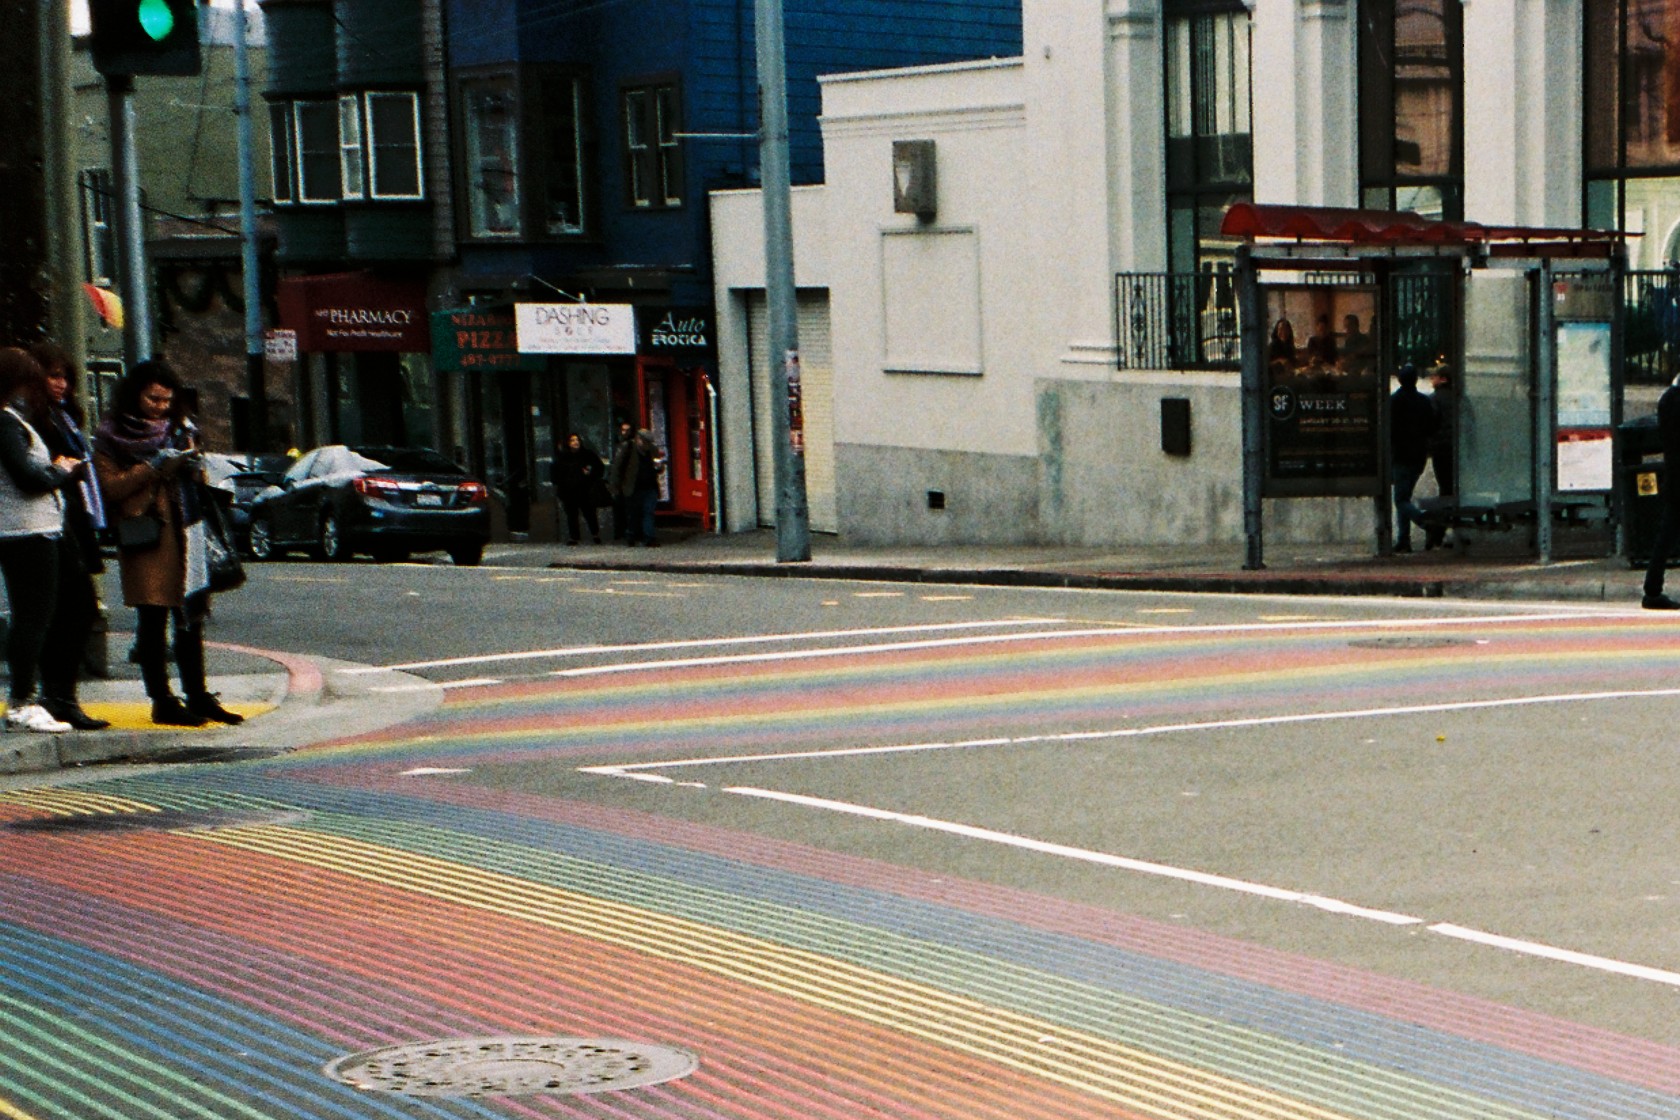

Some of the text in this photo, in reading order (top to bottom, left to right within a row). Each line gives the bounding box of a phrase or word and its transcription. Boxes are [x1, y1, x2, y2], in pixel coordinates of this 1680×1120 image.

[330, 309, 411, 324] PHARMACY
[535, 306, 610, 325] DASHING
[652, 311, 705, 333] Auto
[651, 334, 708, 346] EROTICA
[1273, 395, 1289, 411] SF
[1299, 399, 1346, 410] WEEK
